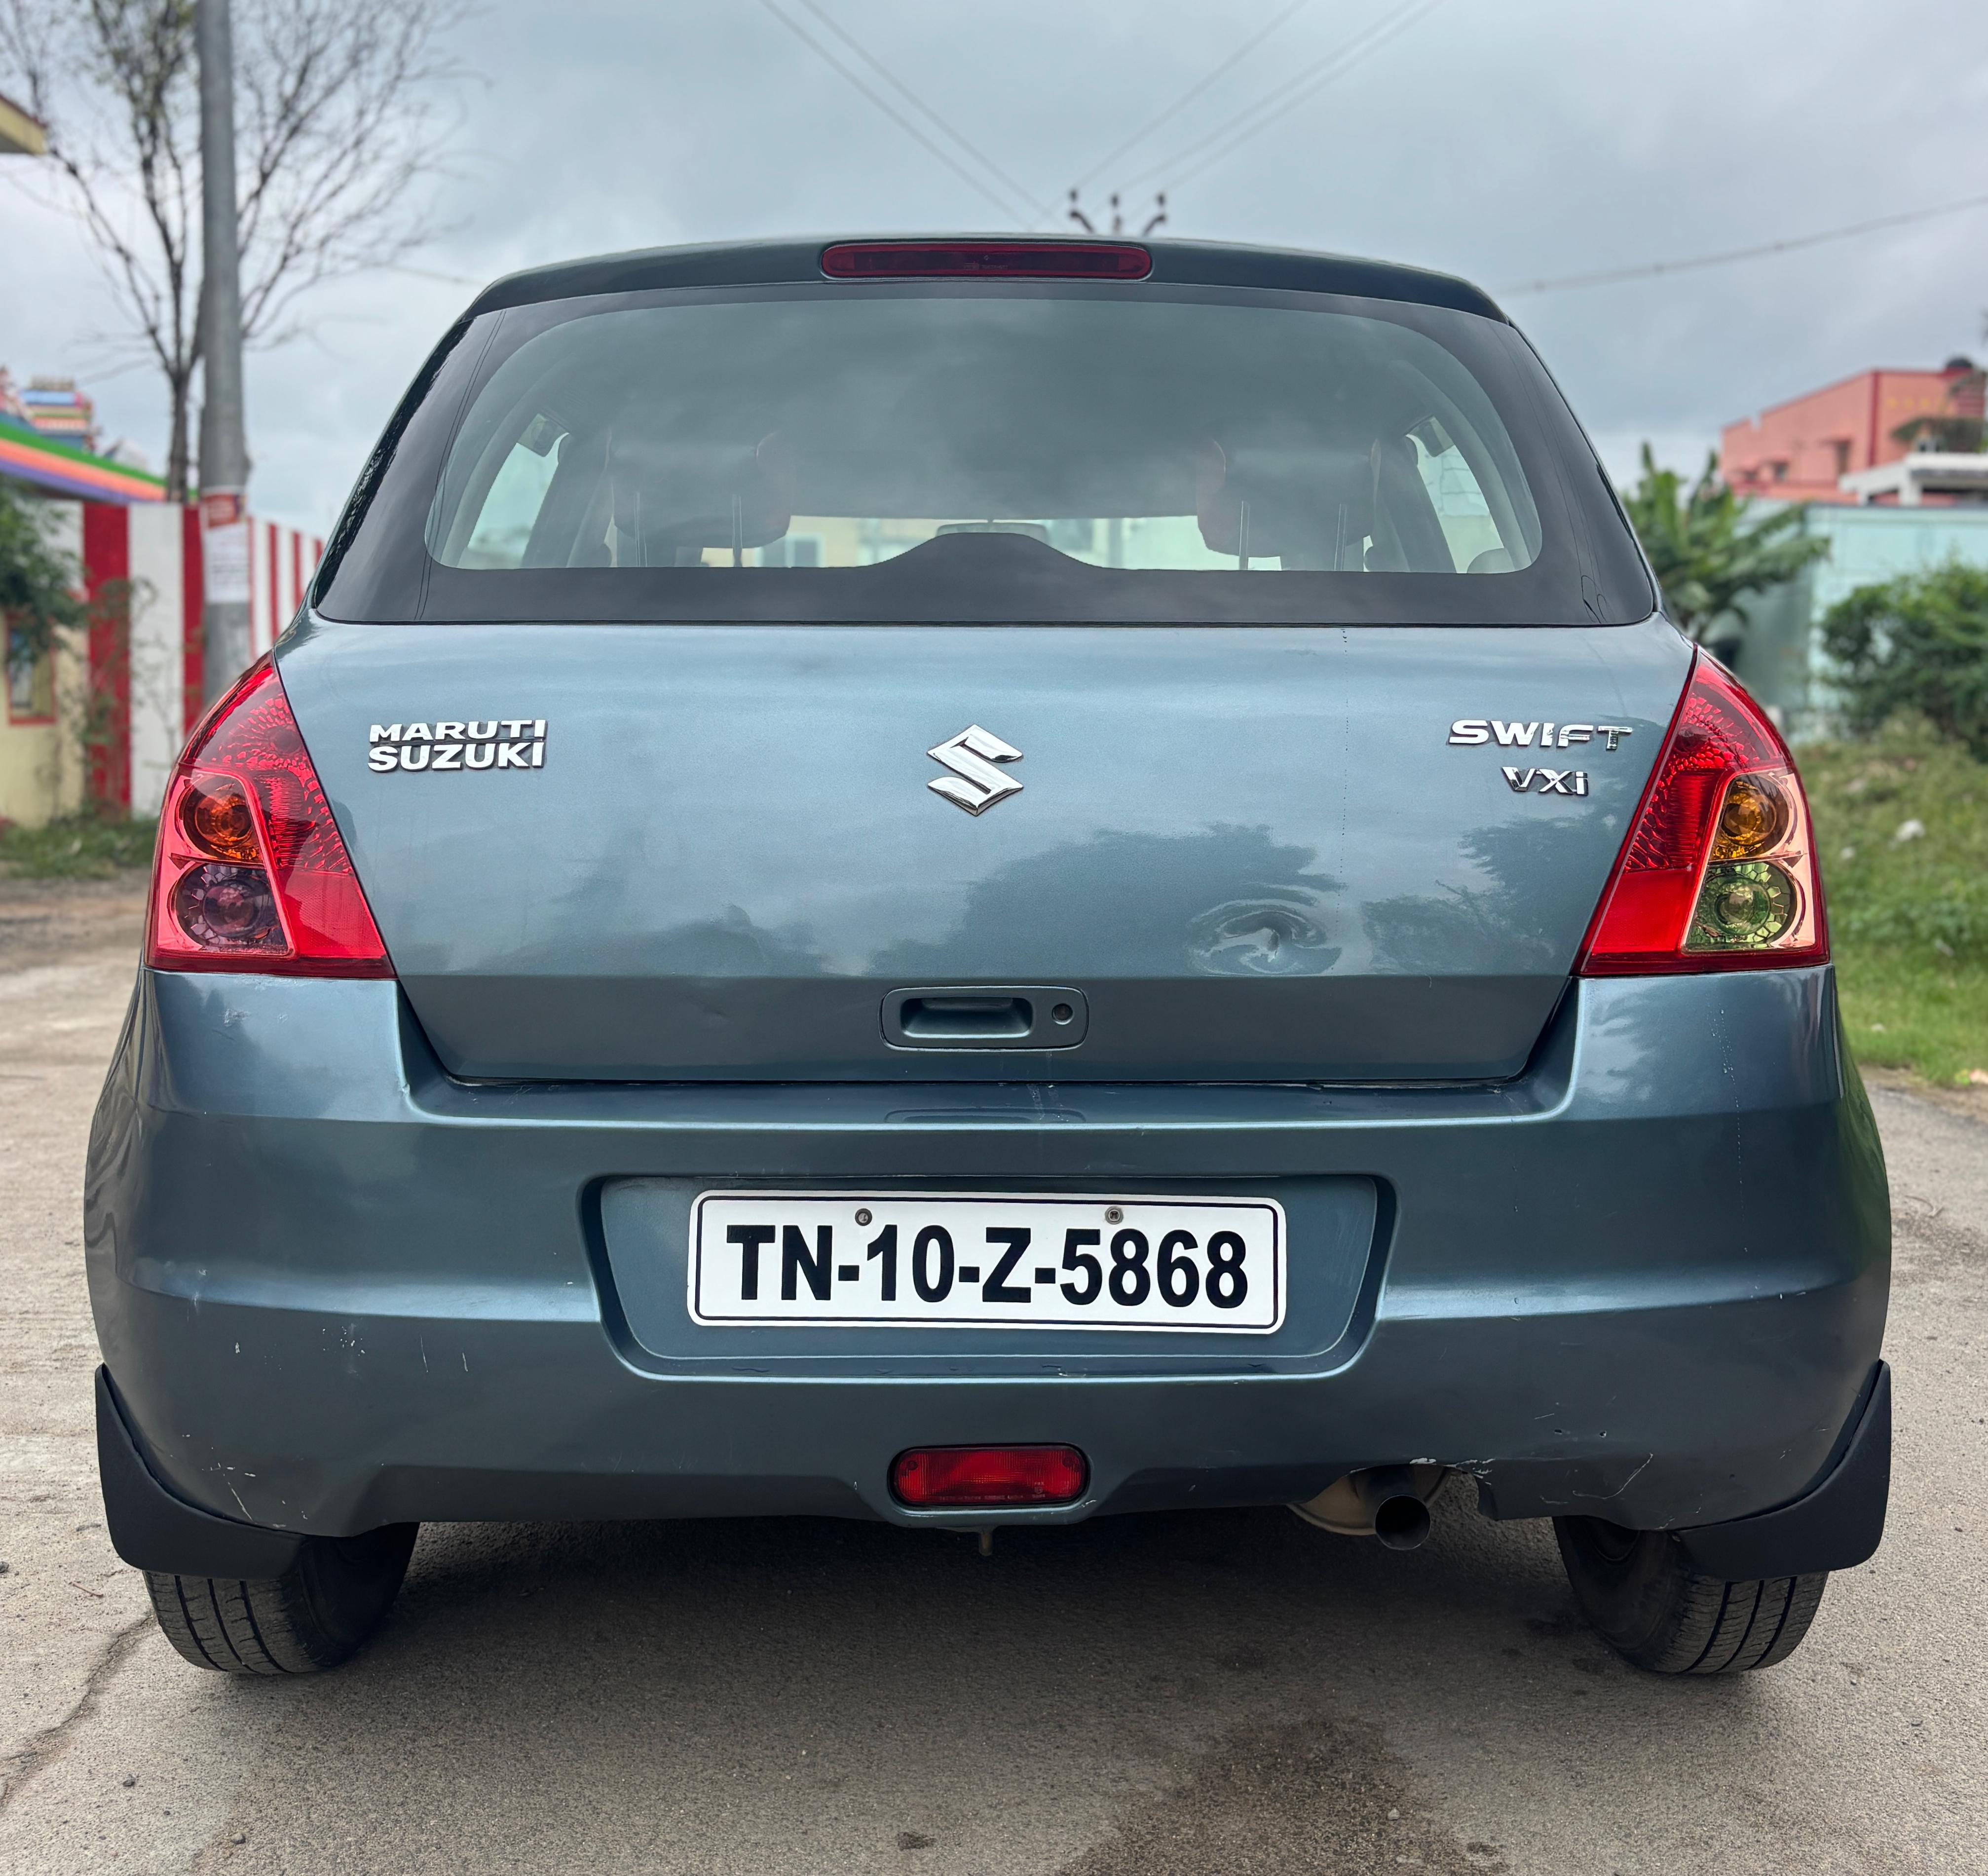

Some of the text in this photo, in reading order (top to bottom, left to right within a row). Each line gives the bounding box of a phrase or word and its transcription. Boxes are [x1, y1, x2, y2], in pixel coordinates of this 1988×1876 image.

[369, 719, 547, 742] MARUTI
[1448, 719, 1633, 751] SWIFT
[368, 742, 545, 773] SUZUKI
[1501, 766, 1589, 796] VXi
[726, 1224, 1248, 1309] TN-10-Z-5868
